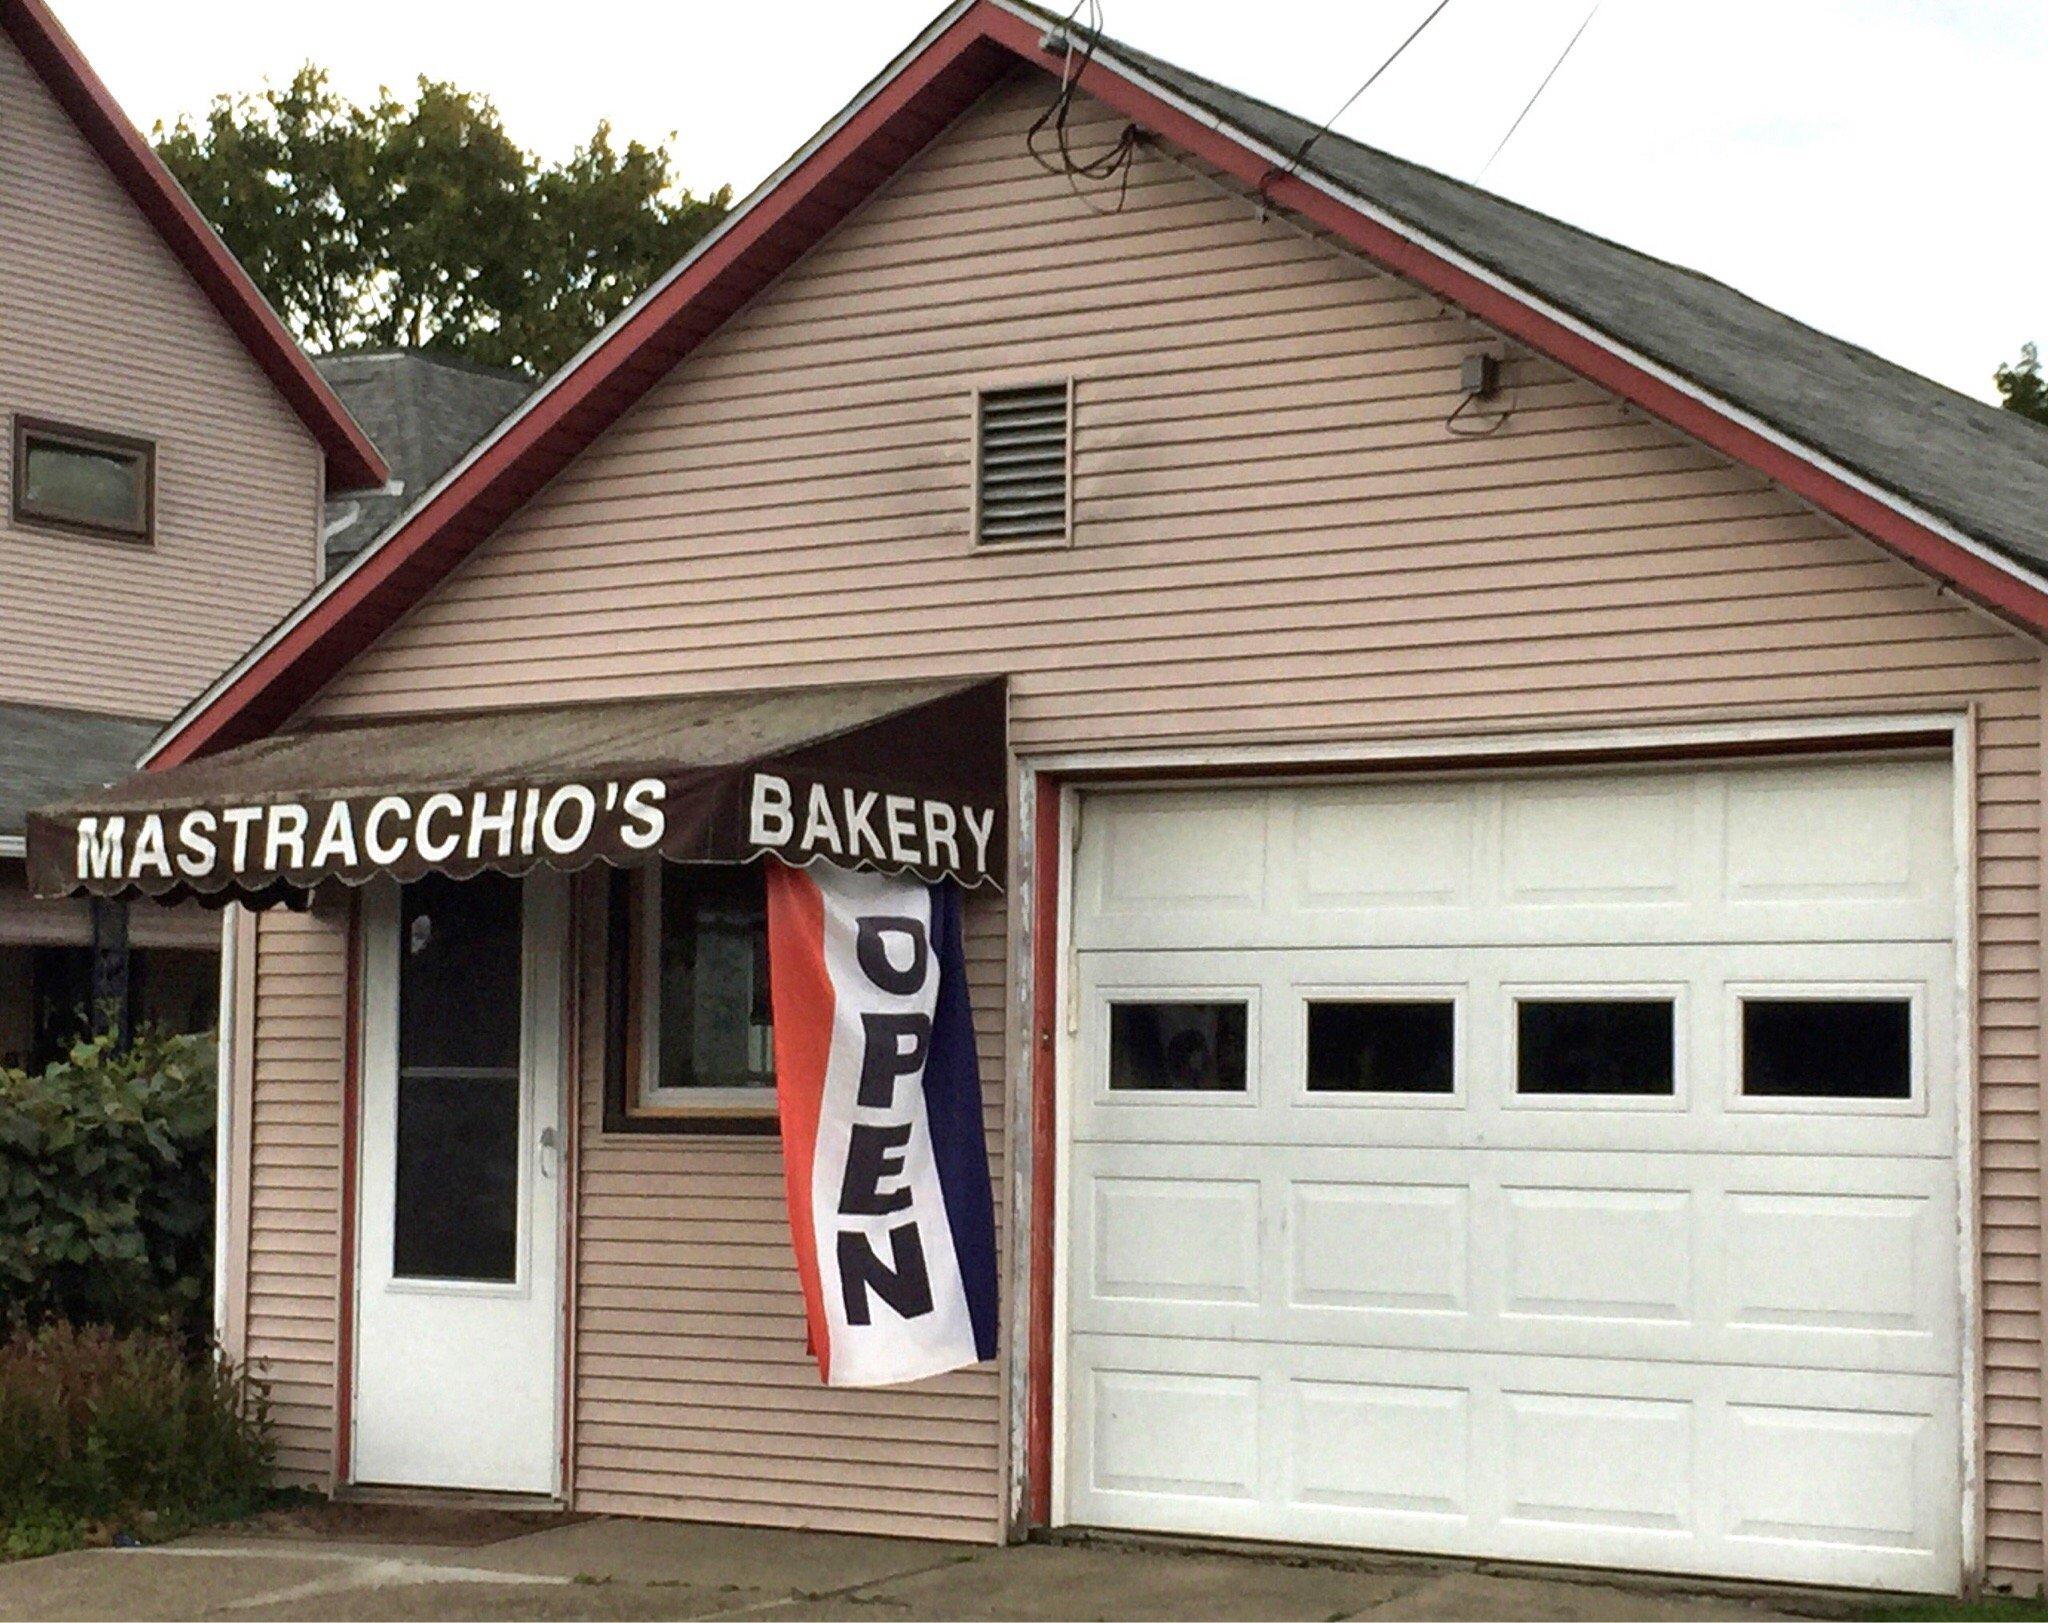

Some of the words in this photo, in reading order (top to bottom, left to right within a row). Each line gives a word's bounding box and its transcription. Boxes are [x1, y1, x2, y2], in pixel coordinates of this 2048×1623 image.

[76, 778, 667, 879] MASTRACCHIO'S
[749, 773, 995, 873] BAKERY
[837, 915, 935, 1327] OPEN
